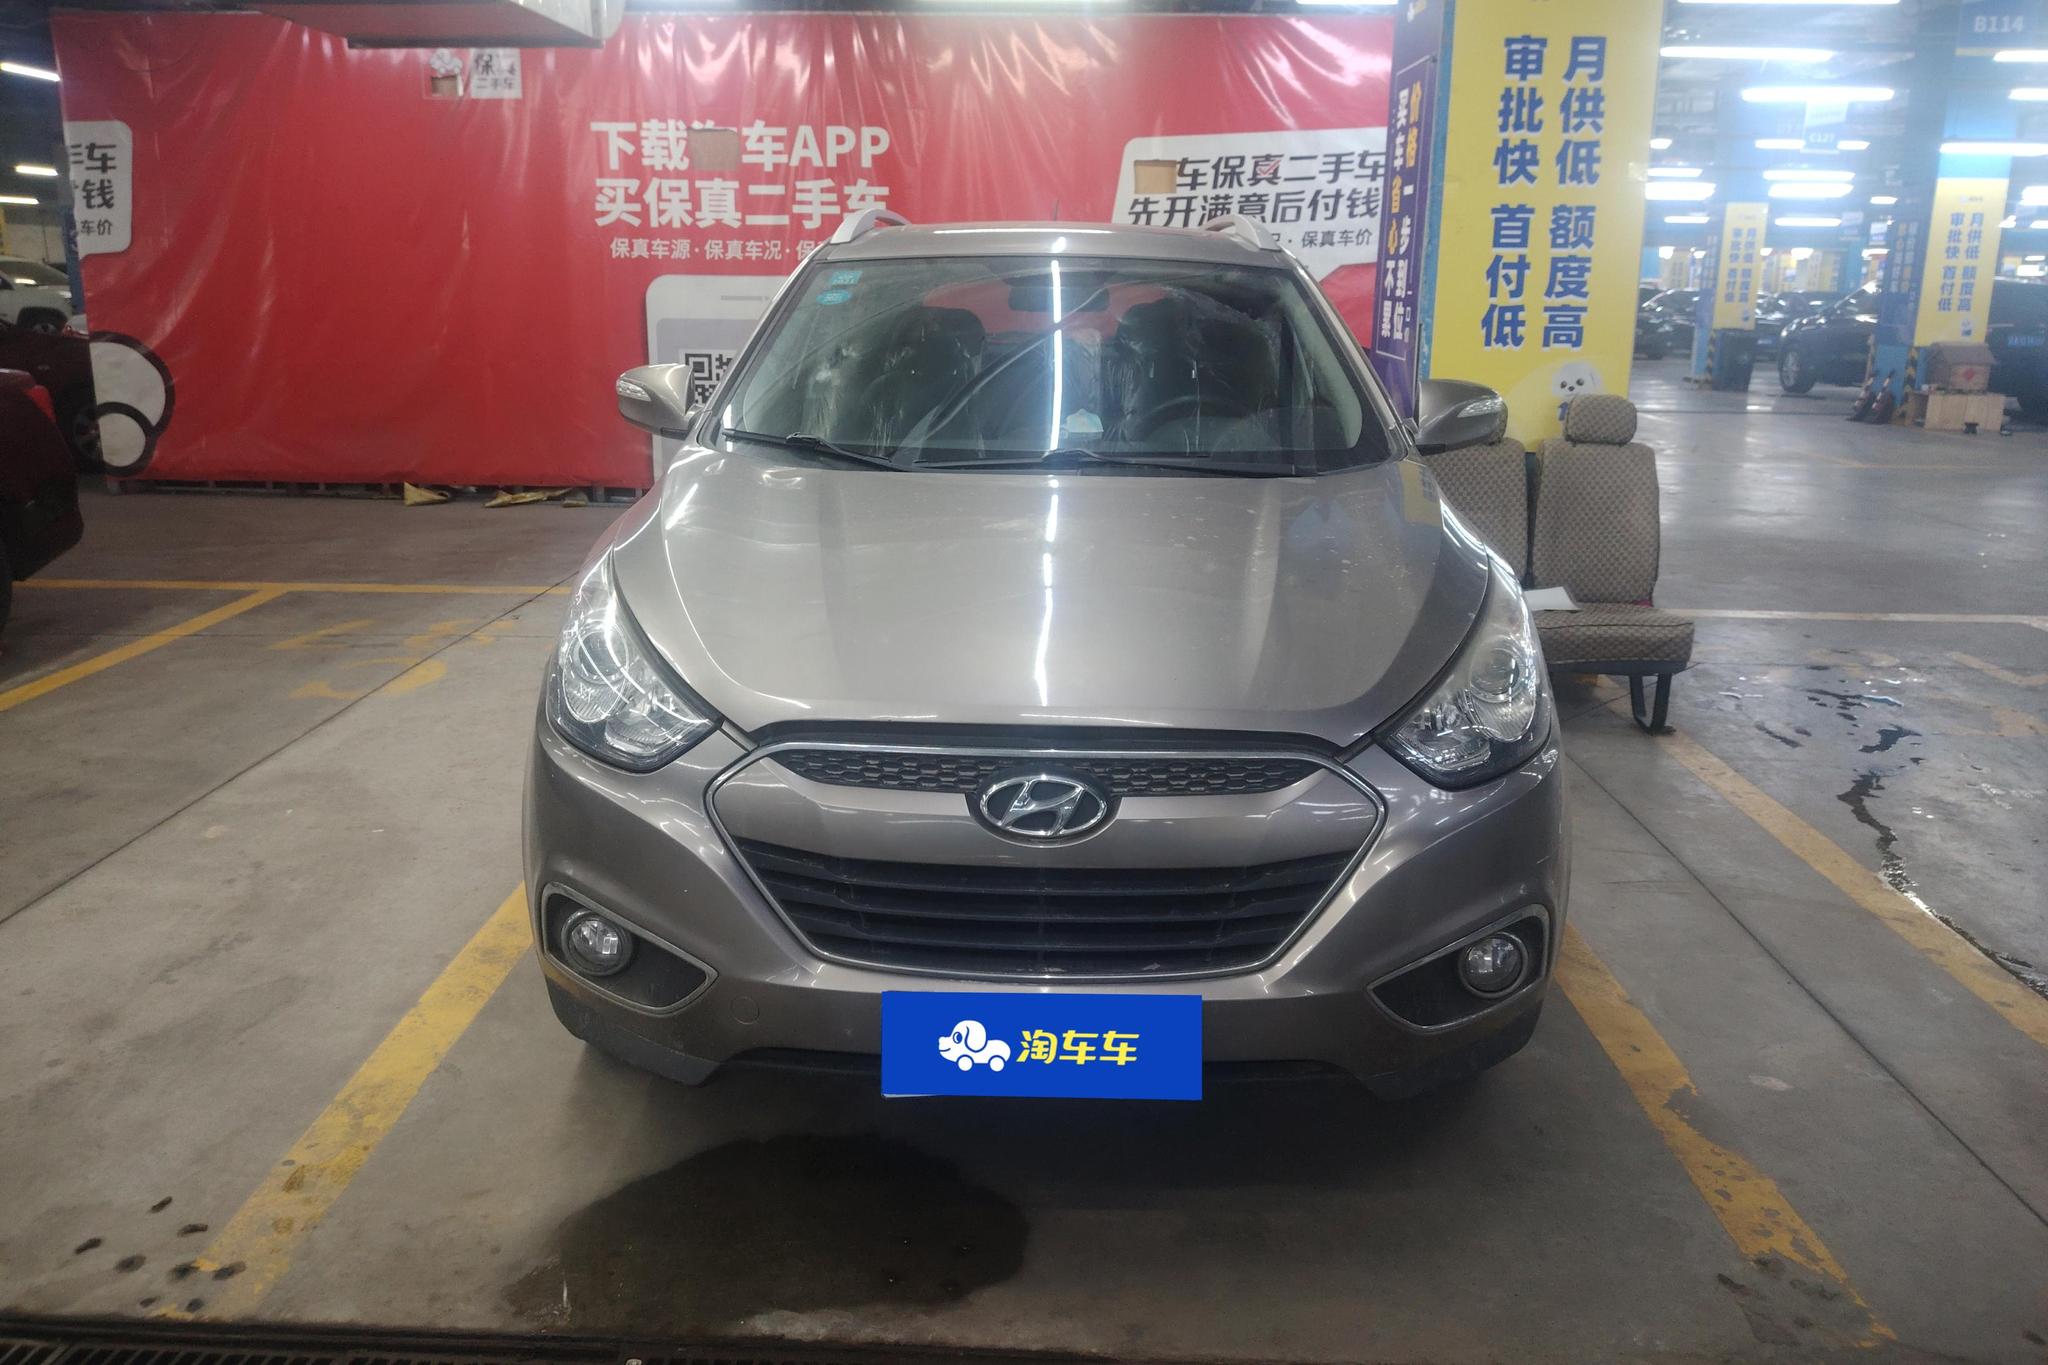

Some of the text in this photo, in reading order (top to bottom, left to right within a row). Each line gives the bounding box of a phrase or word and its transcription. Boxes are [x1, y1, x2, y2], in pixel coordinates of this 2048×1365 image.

[1974, 15, 2024, 33] B114
[590, 119, 891, 171] 下载车APP
[1134, 150, 1387, 194] 车保真二手车
